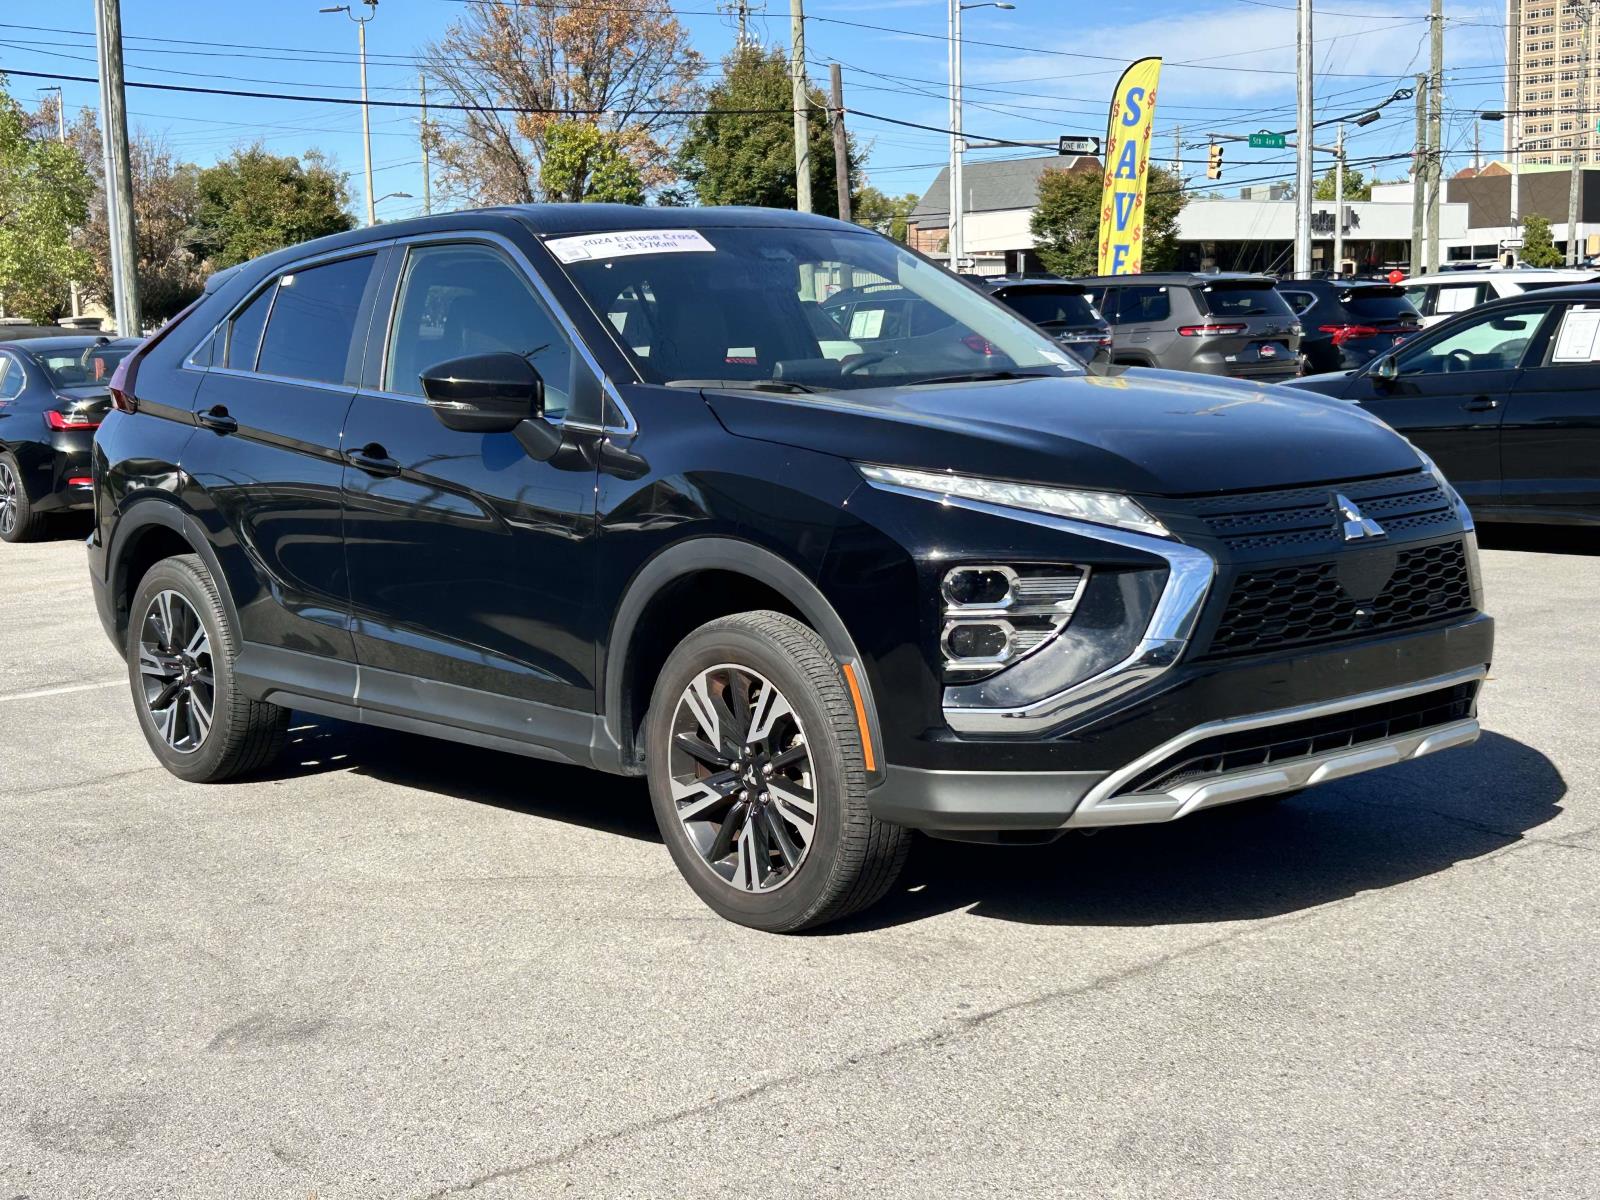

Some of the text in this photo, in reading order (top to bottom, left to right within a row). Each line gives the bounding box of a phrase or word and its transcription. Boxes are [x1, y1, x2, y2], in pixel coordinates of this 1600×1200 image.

[1063, 142, 1088, 151] ONE WAY
[1112, 86, 1145, 275] SAVE
[583, 232, 698, 247] 2024 Eclipse Cross
[617, 242, 637, 250] SE
